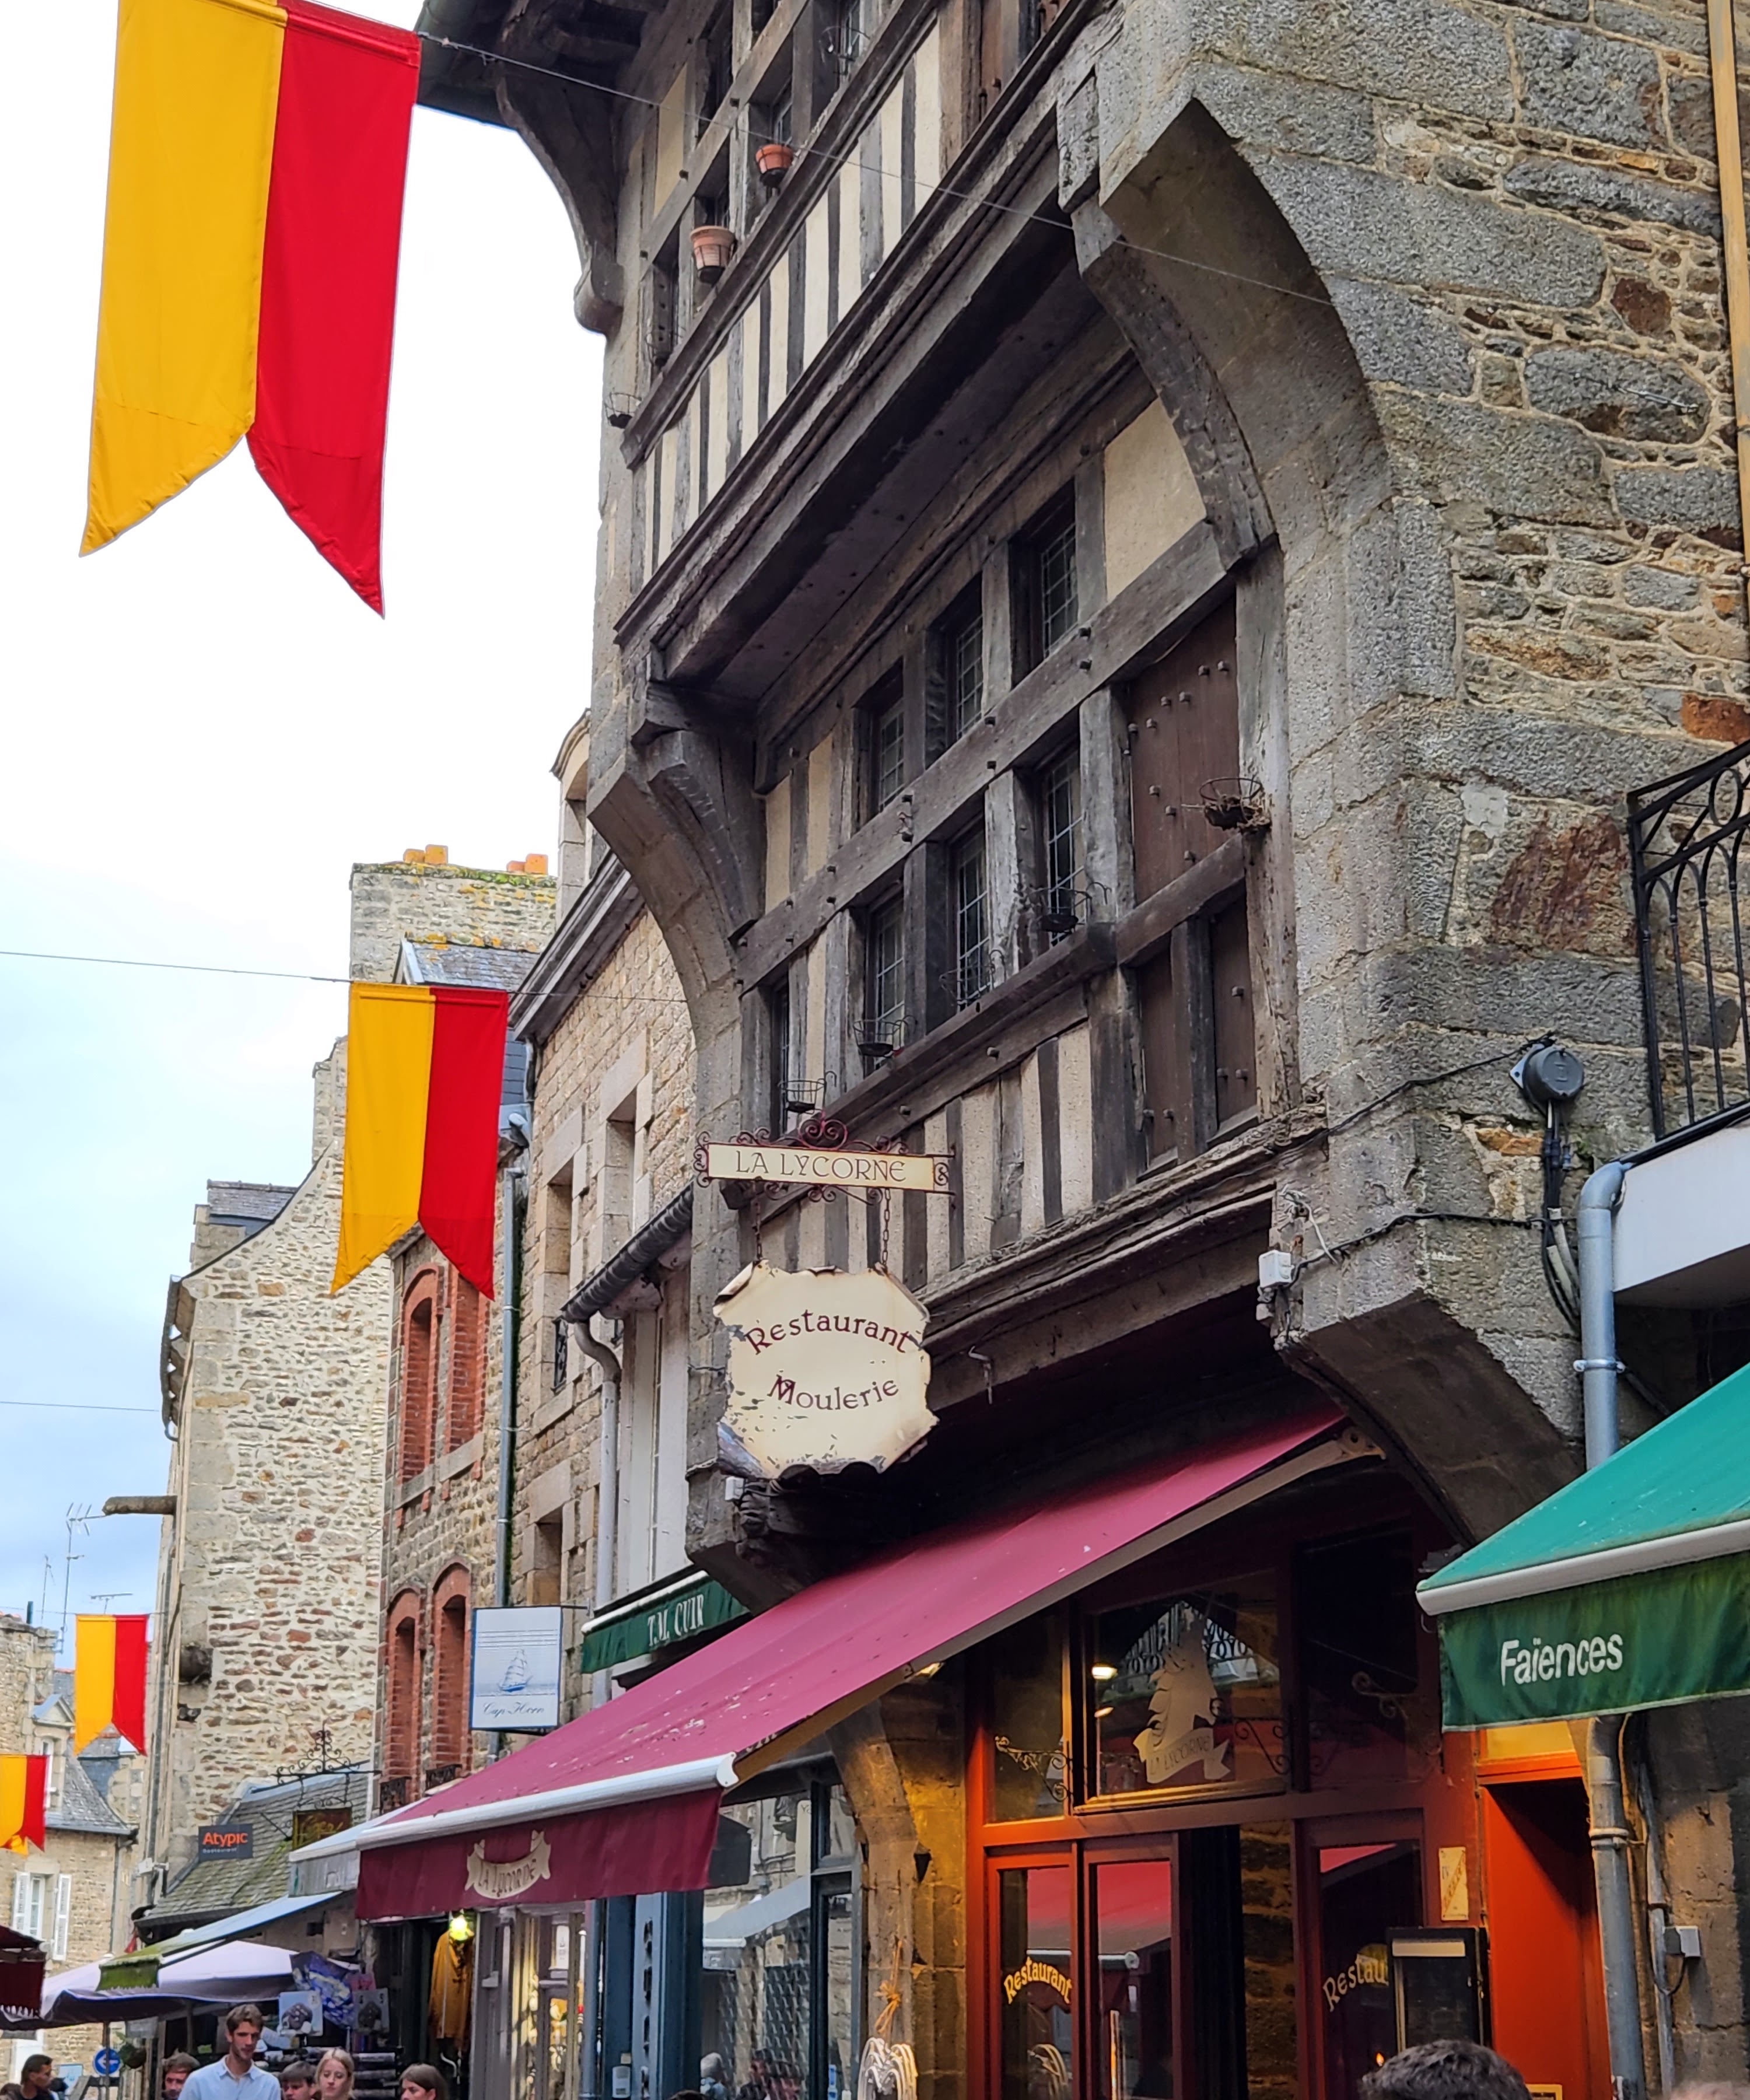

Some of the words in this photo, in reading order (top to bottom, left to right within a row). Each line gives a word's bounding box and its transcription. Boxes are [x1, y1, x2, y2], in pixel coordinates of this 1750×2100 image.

[736, 1150, 769, 1174] LA
[780, 1153, 906, 1182] LYCORNE
[744, 1309, 907, 1355] Restaurant
[766, 1374, 899, 1410] Moulerie
[674, 1594, 704, 1636] CUIR
[1500, 1633, 1623, 1687] Faïences
[483, 1702, 505, 1718] Cap
[508, 1701, 545, 1715] Horn
[1003, 1955, 1073, 2004] Restaurant
[1322, 1953, 1390, 2013] Restau
